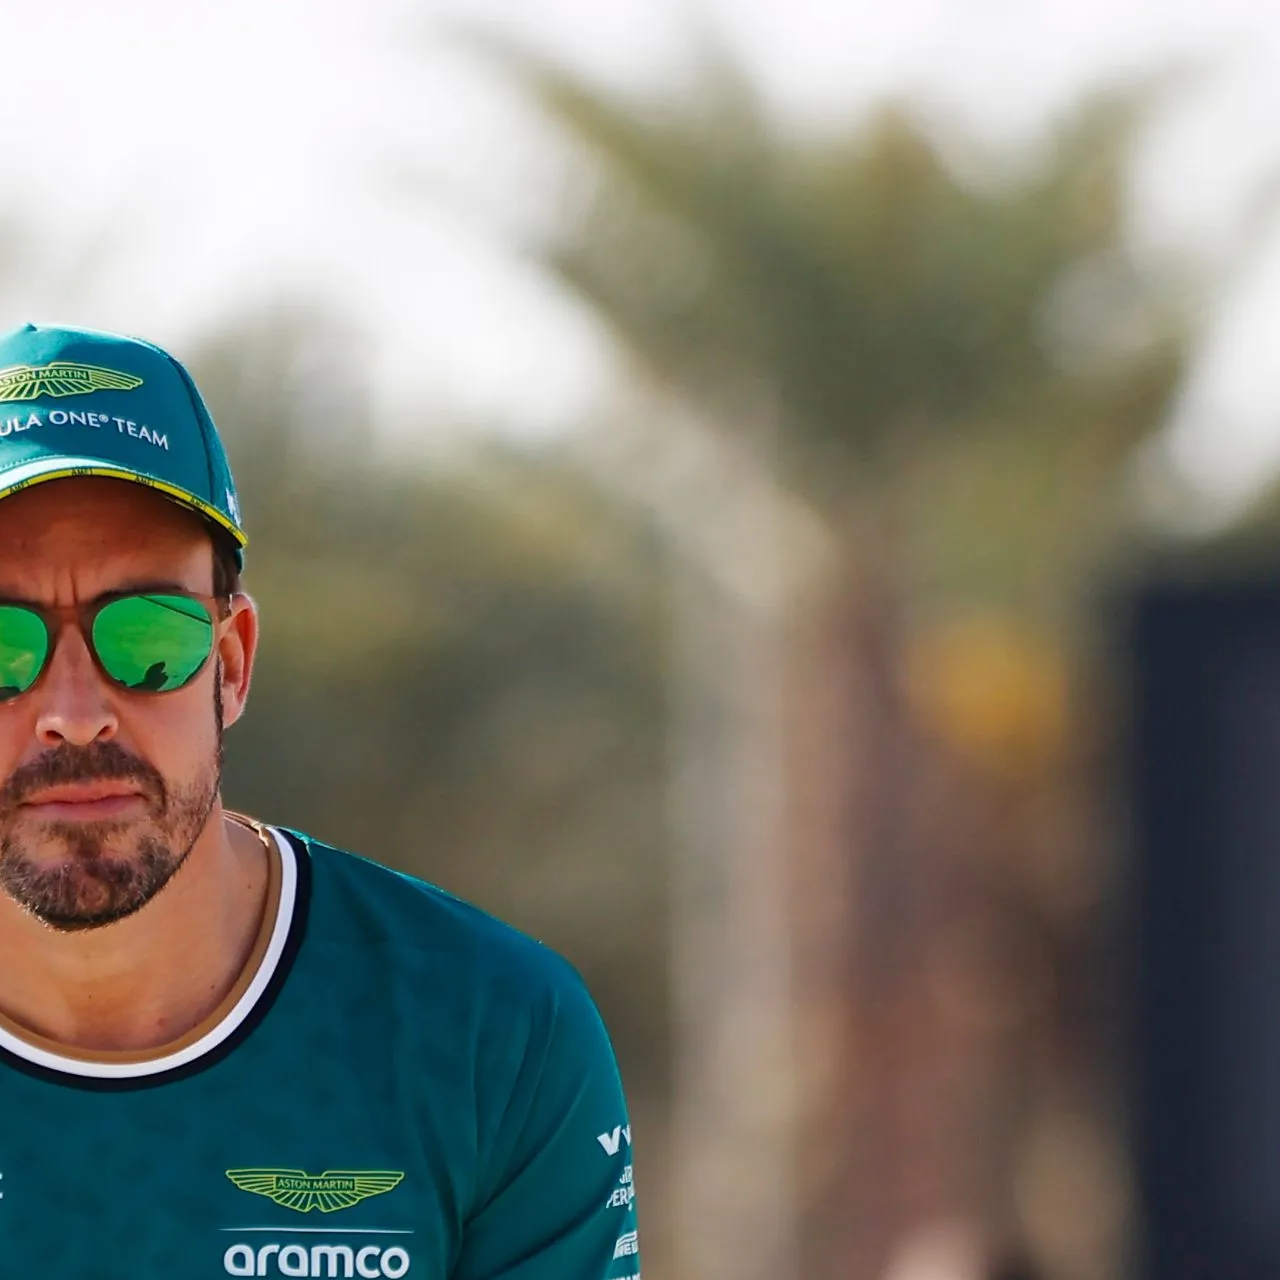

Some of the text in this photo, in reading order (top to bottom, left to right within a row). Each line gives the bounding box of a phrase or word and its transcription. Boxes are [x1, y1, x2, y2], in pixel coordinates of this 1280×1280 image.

[38, 369, 88, 380] MARTIN
[112, 417, 169, 450] TEAM
[277, 1178, 354, 1190] ASTON MARTIN
[223, 1244, 410, 1280] aramco
